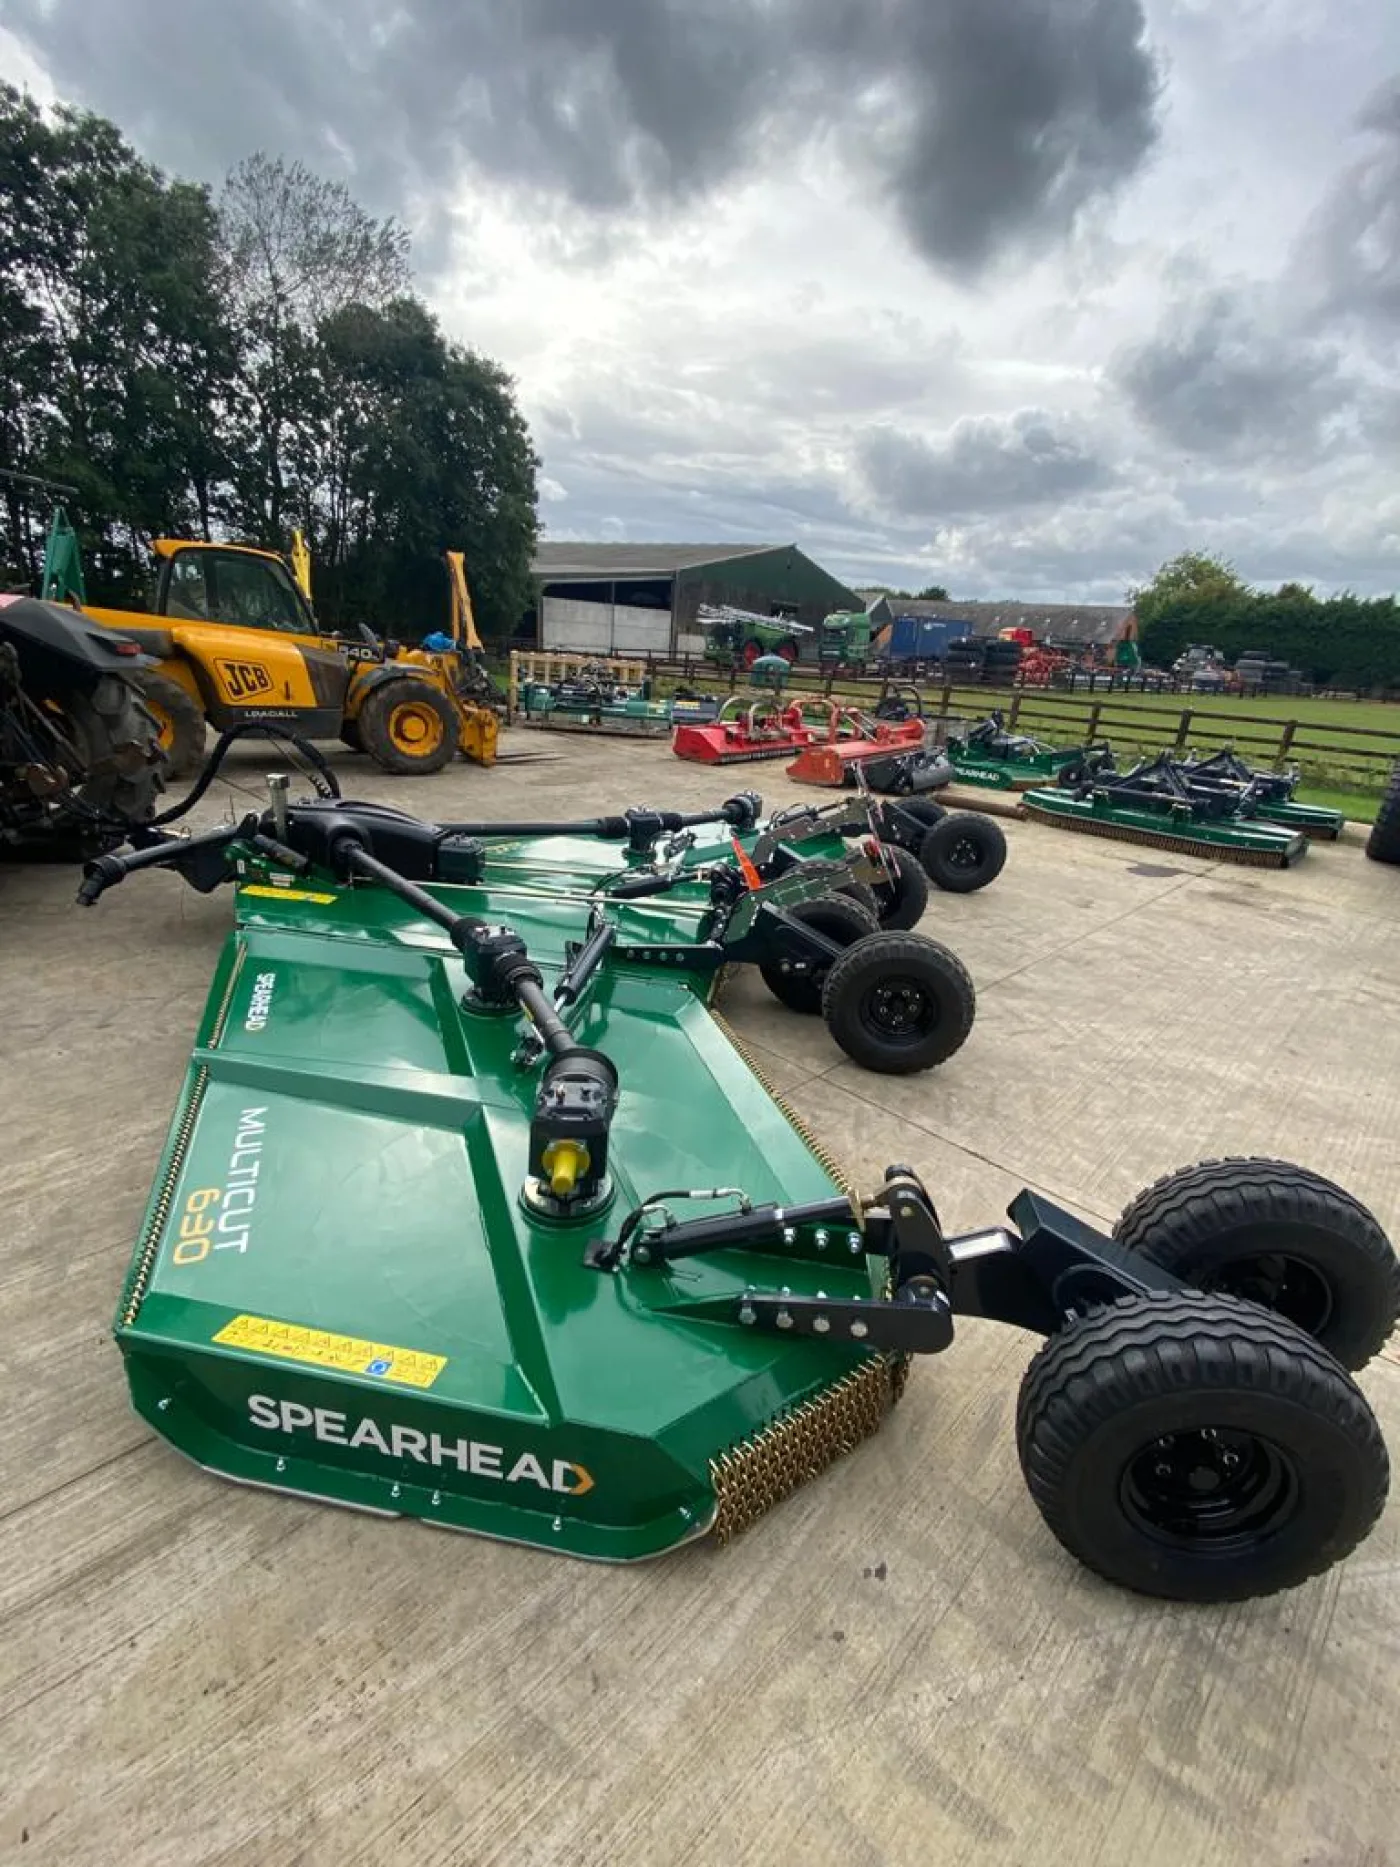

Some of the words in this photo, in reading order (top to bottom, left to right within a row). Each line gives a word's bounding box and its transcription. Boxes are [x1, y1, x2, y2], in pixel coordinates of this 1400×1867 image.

[224, 663, 269, 696] JCB
[954, 766, 1000, 781] PEARHEAD
[245, 973, 276, 1031] SPEARHEAD
[213, 1106, 269, 1254] MULTICUT
[172, 1187, 221, 1265] 630
[247, 1394, 595, 1495] SPEARHEAD
